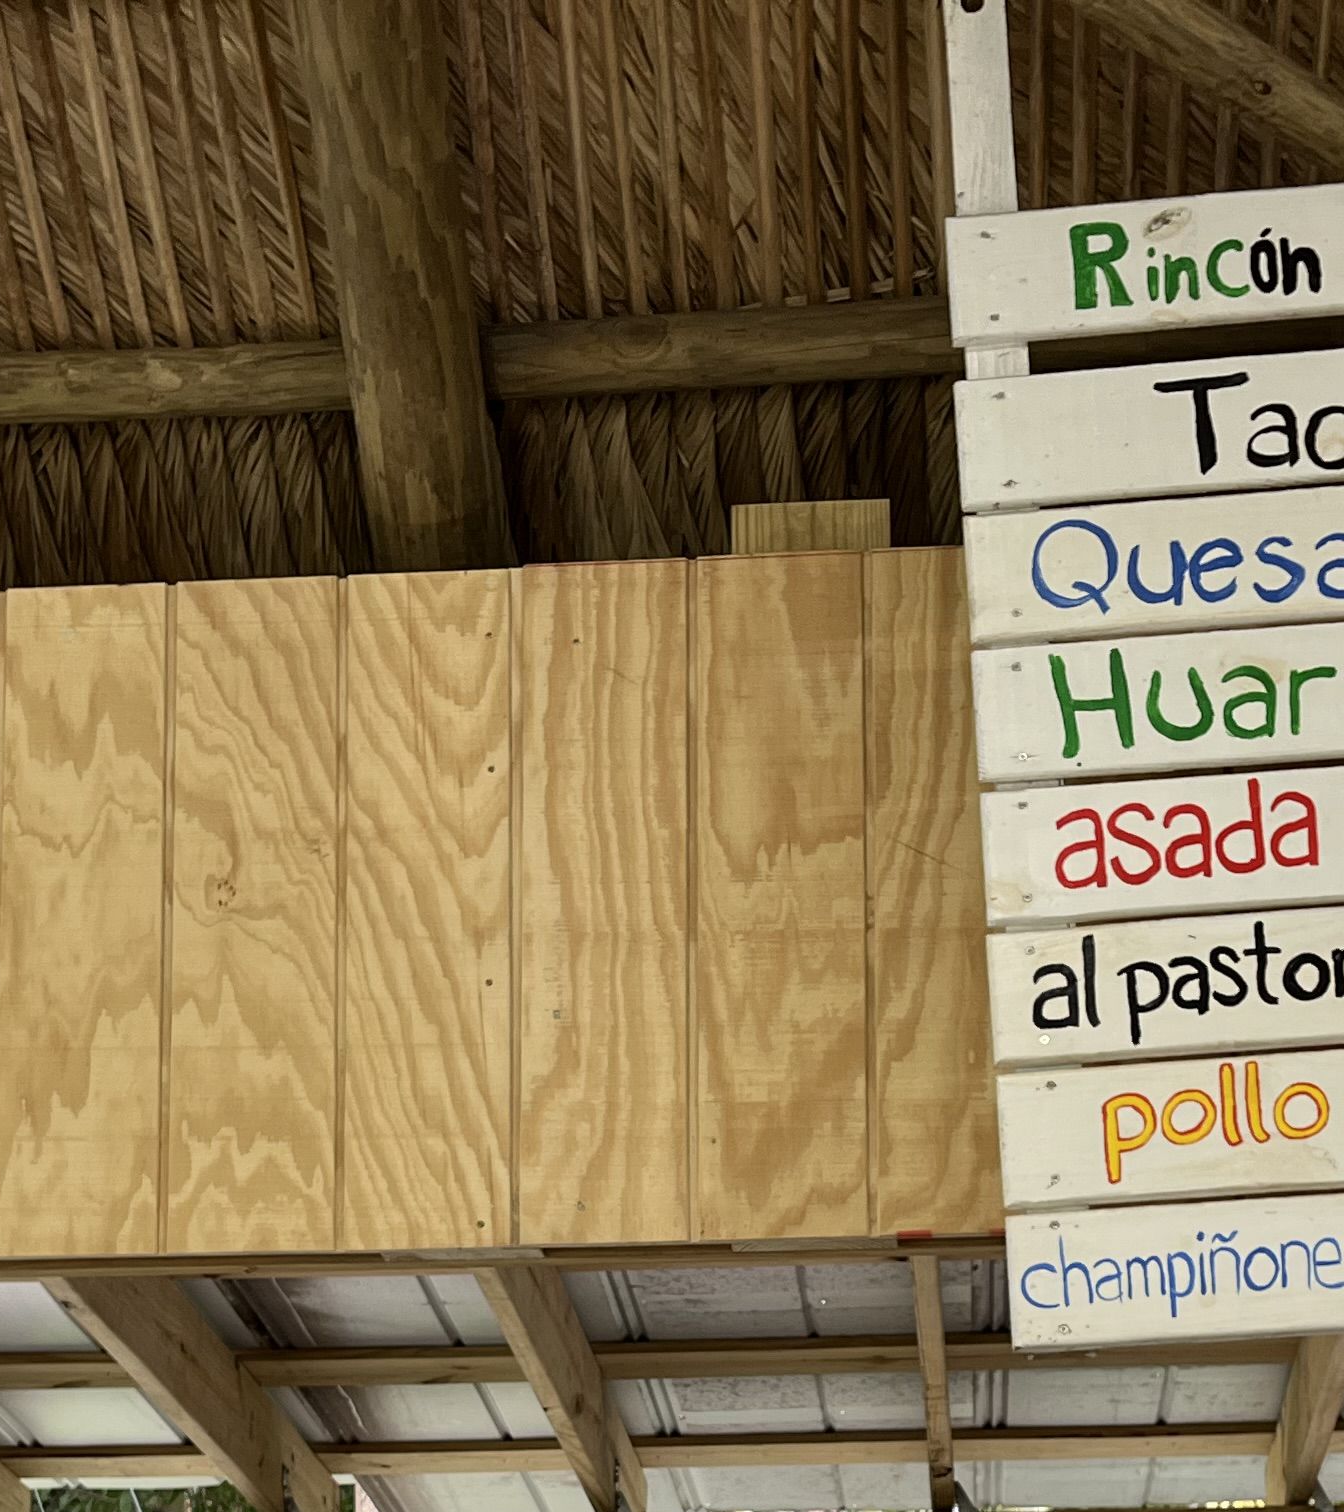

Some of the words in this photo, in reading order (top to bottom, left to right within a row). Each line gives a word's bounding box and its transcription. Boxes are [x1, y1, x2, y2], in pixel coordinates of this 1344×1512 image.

[1069, 217, 1323, 310] Rincón
[1055, 778, 1320, 890] asada
[1032, 934, 1101, 1030] al
[1101, 1060, 1330, 1184] pollo
